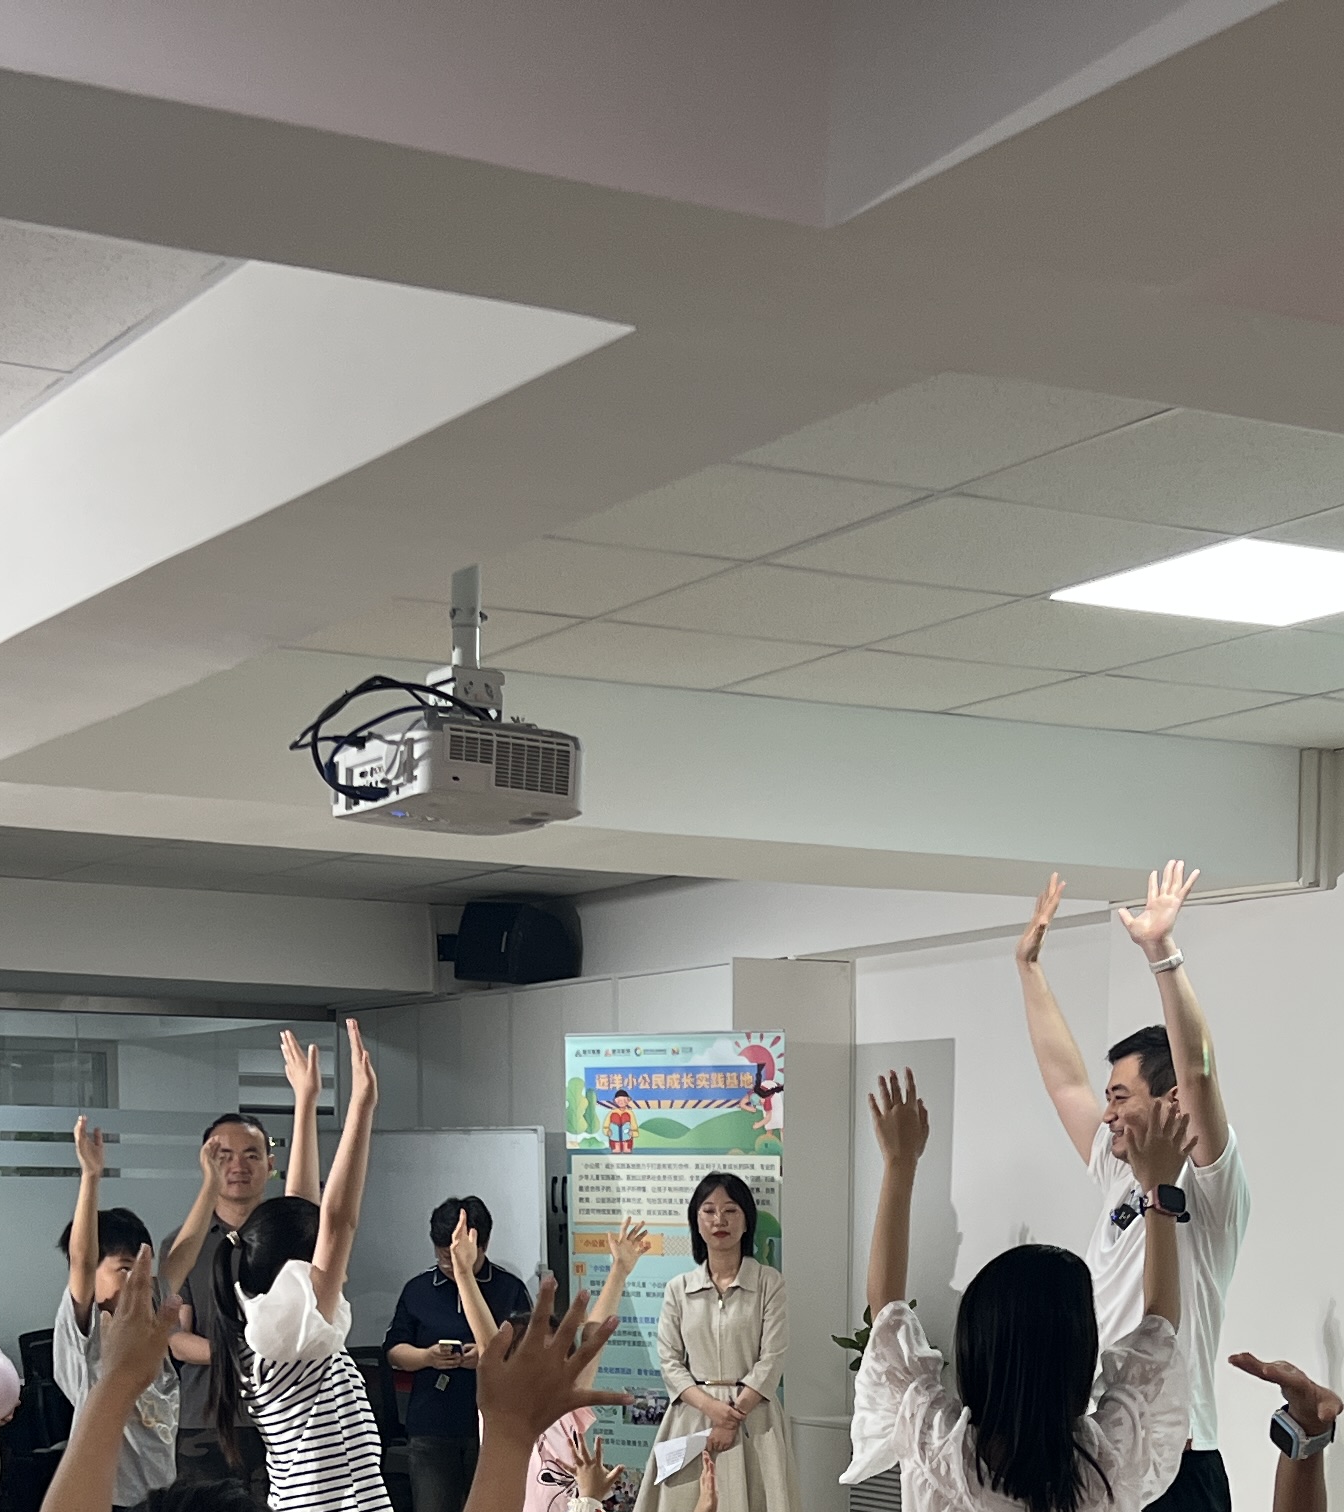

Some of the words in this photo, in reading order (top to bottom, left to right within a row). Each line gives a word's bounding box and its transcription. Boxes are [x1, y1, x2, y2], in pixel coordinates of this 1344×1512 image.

[595, 1072, 755, 1091] 远洋小公民成长实践基地
